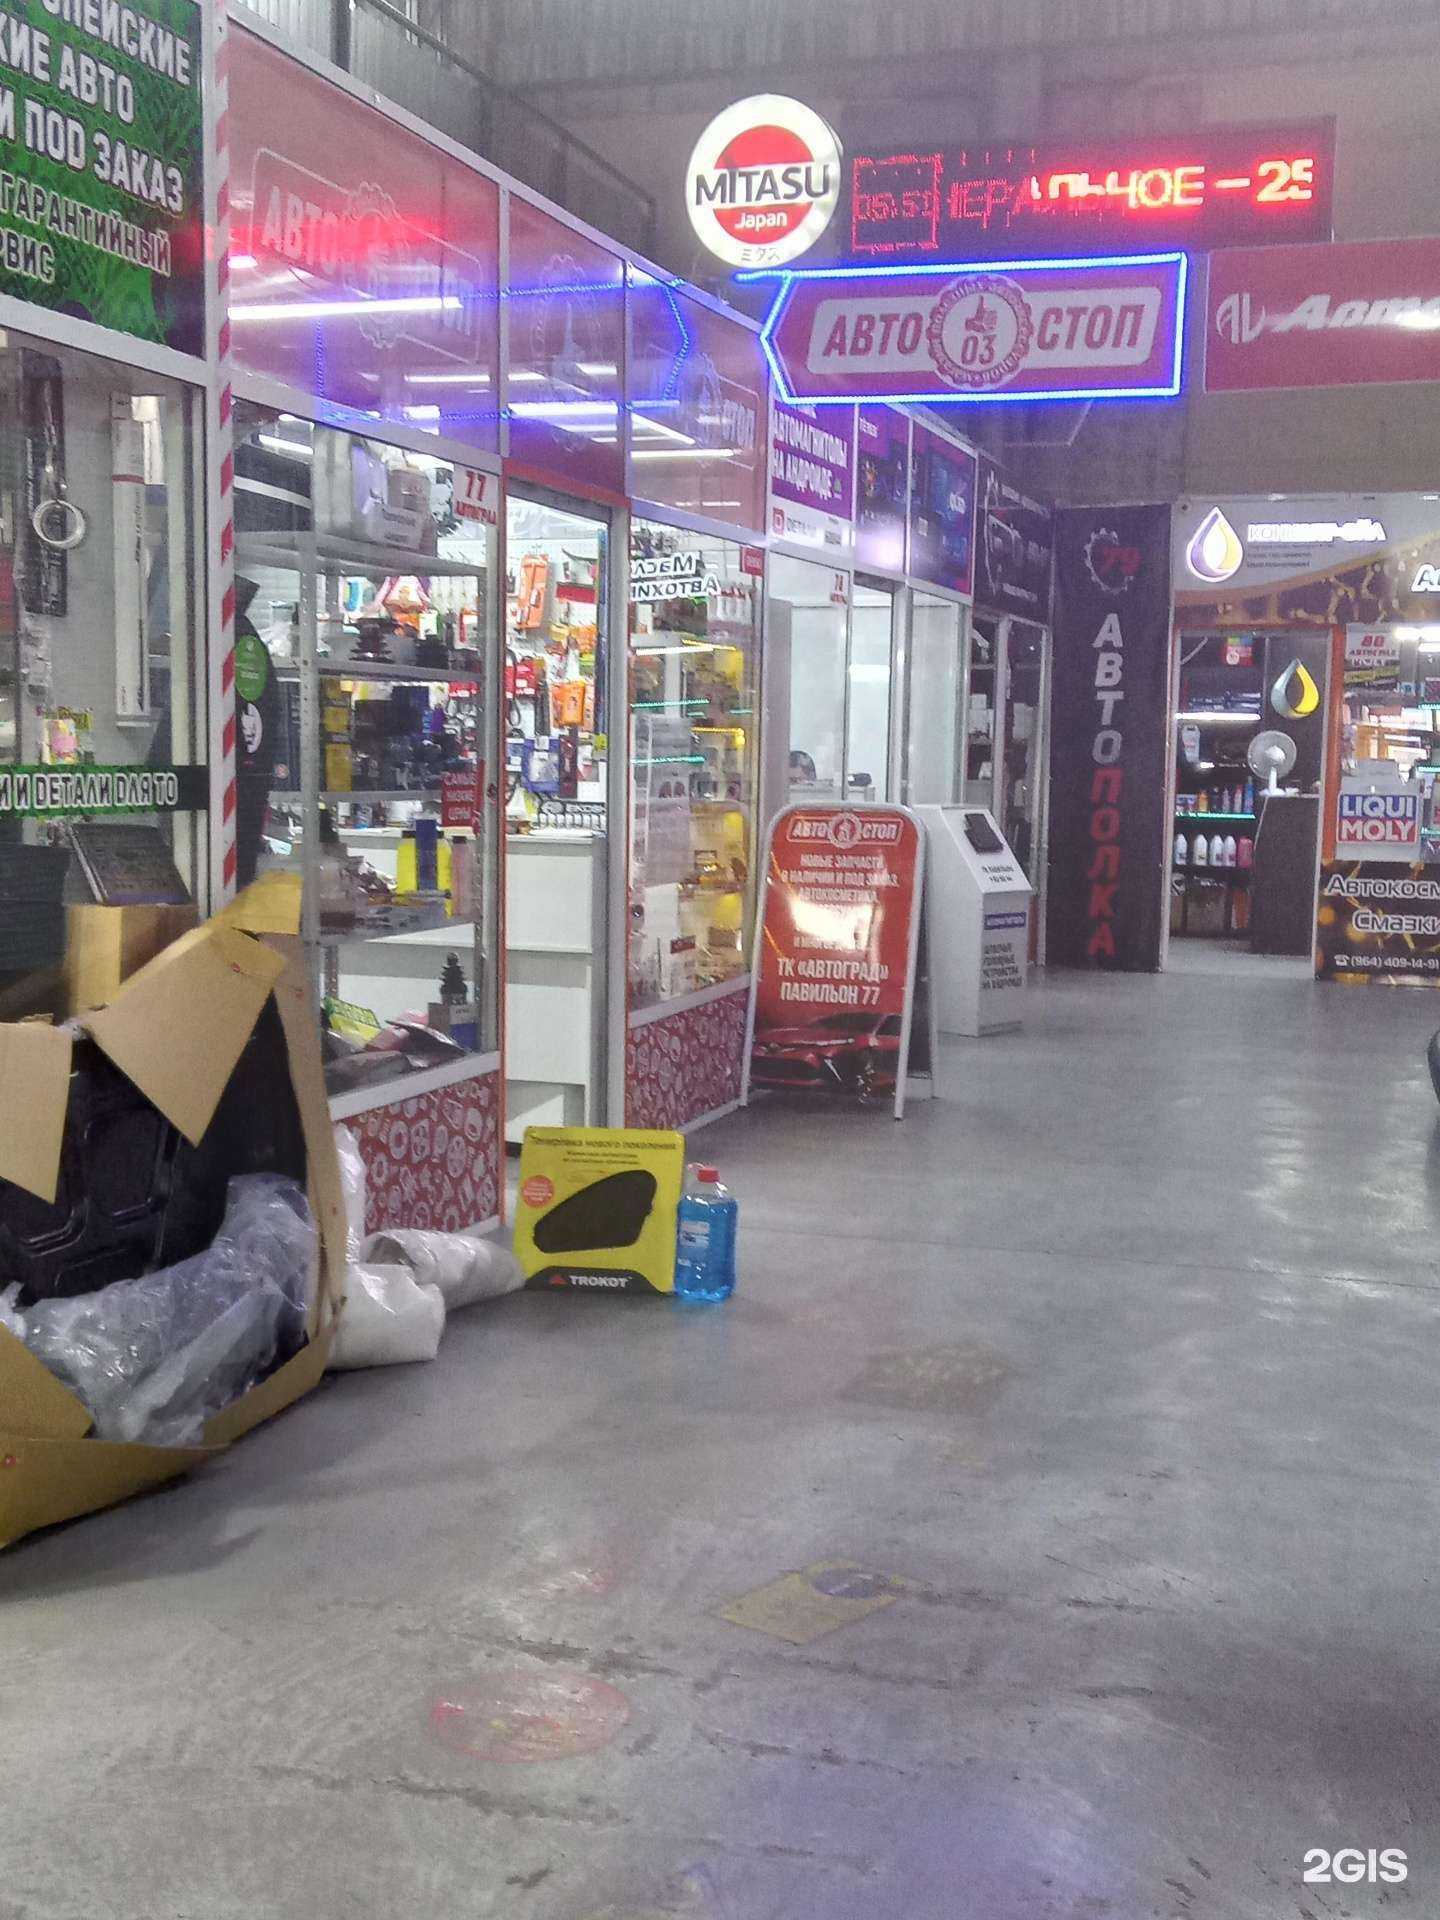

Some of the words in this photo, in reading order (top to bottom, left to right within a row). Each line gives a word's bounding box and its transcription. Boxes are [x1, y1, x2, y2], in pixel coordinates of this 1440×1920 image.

[59, 44, 134, 124] АВТО
[93, 131, 184, 213] ЗАКАЗ
[695, 164, 830, 206] MITASU
[734, 211, 788, 231] Japan
[822, 312, 923, 358] АВТО
[961, 334, 996, 365] 03
[1036, 304, 1147, 351] СТОП
[465, 470, 487, 502] 77
[1087, 612, 1125, 957] АВТОПОЛКА
[1342, 796, 1413, 818] LIQUI
[793, 820, 829, 838] АВТО
[862, 823, 897, 839] СТОП
[1341, 819, 1415, 841] MOLY
[777, 957, 795, 977] ТК
[798, 958, 889, 983] «АВТОГРАД»
[781, 982, 858, 1005] ПАВИЛЬОН
[862, 986, 880, 1006] 77
[569, 1275, 629, 1288] TROKOT
